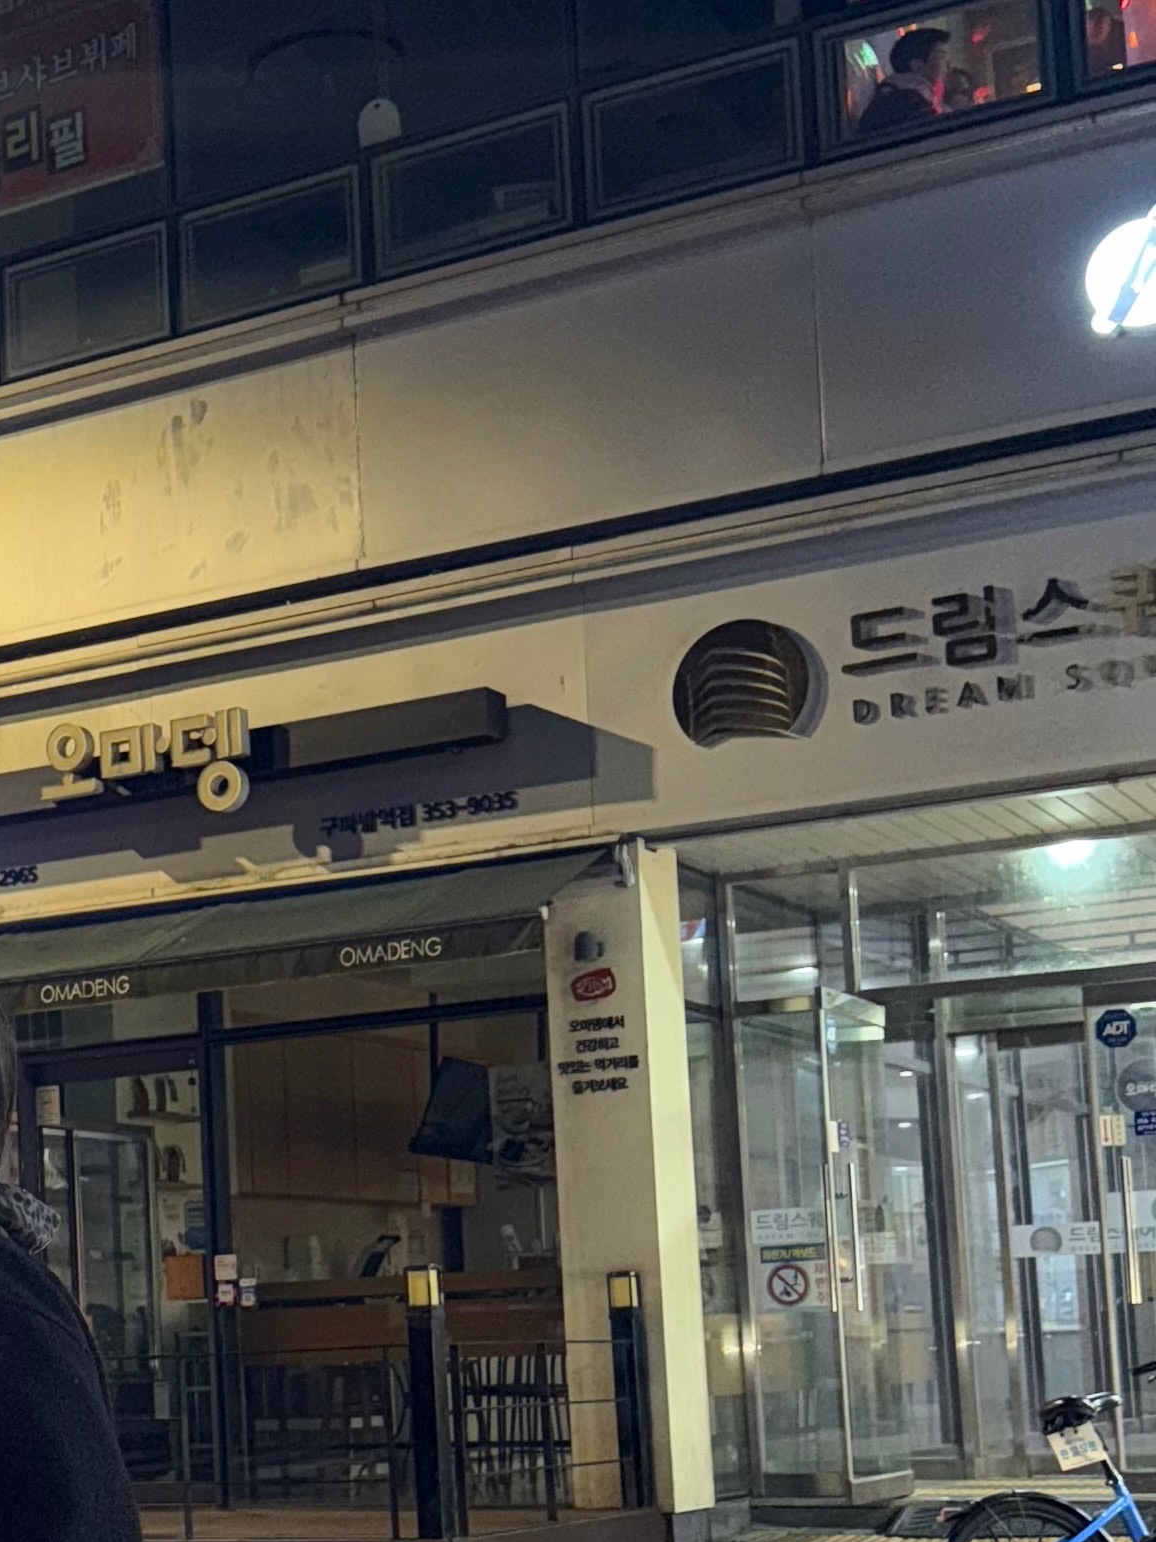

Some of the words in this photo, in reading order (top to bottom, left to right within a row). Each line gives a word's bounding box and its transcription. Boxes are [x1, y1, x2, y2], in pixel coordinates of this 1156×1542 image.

[853, 674, 1035, 726] DREAM
[40, 707, 250, 812] 오마뎅
[339, 936, 442, 968] OMADENG
[40, 974, 130, 1005] OMADENG
[1102, 1020, 1130, 1037] ADT
